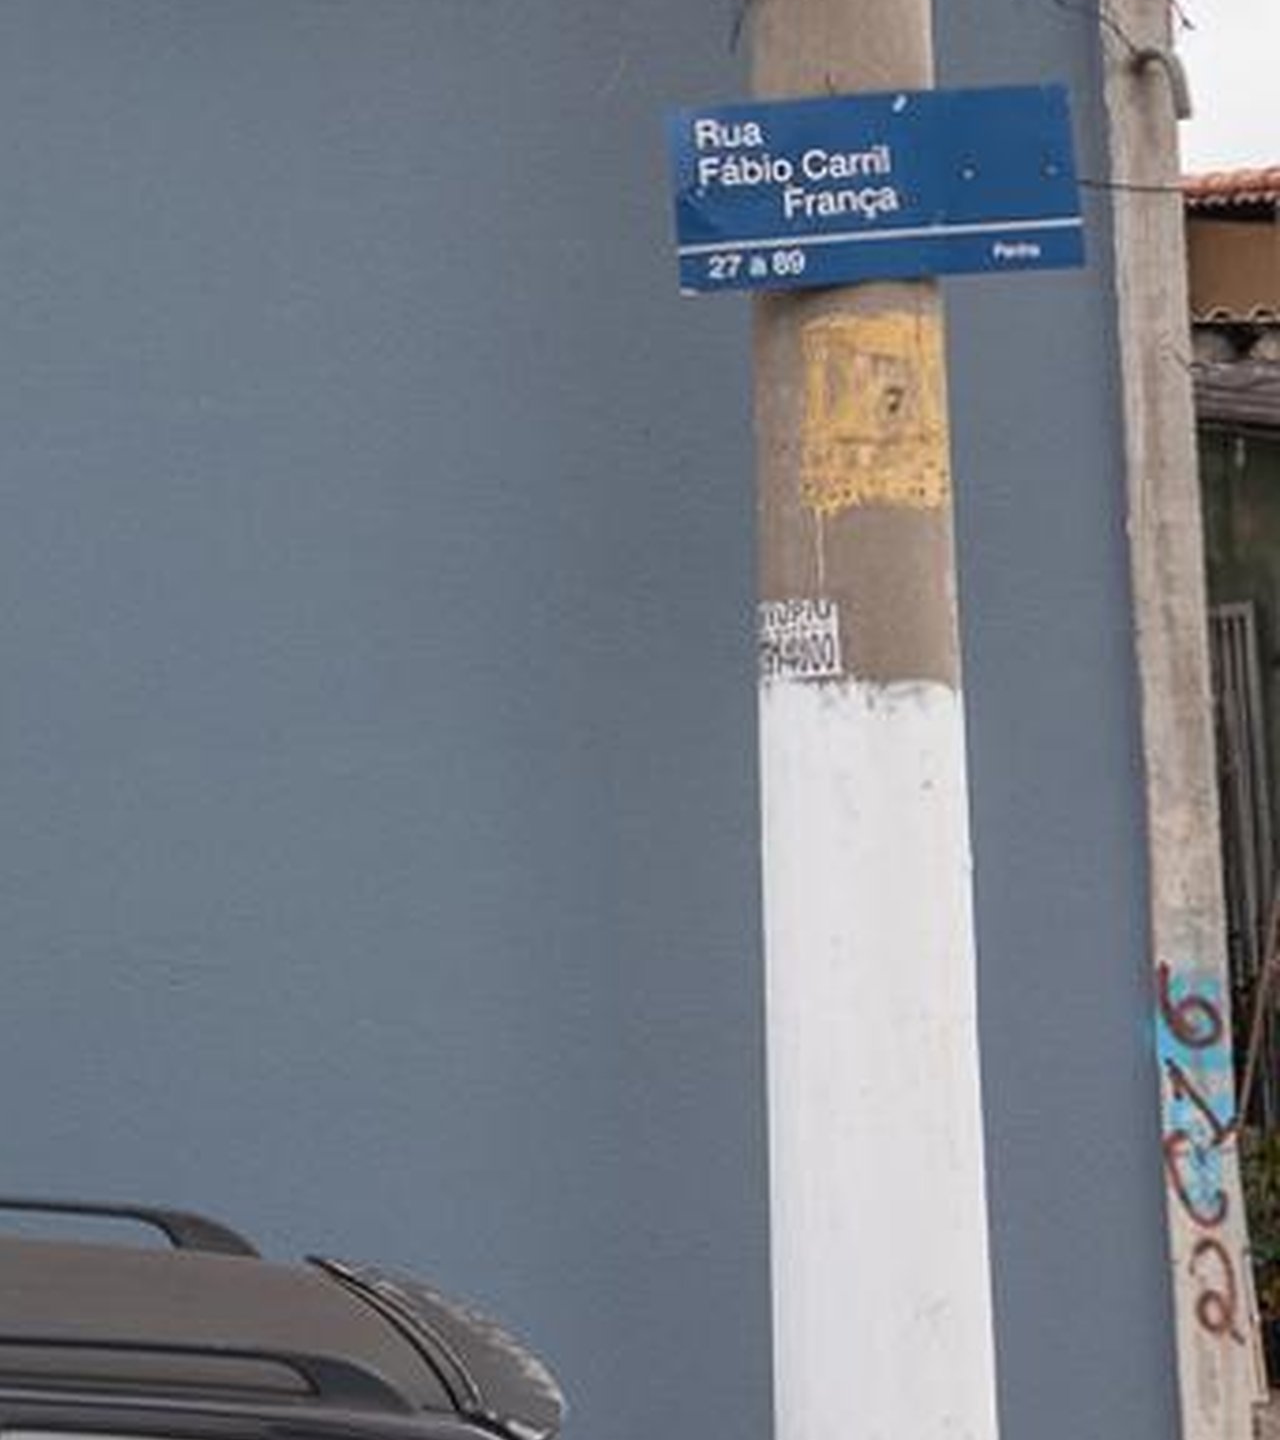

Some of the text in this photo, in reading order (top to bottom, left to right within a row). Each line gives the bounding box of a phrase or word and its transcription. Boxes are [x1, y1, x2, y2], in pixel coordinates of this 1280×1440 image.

[694, 119, 763, 151] Rua
[698, 152, 794, 187] Fábio
[783, 184, 899, 219] França
[708, 254, 742, 279] 27
